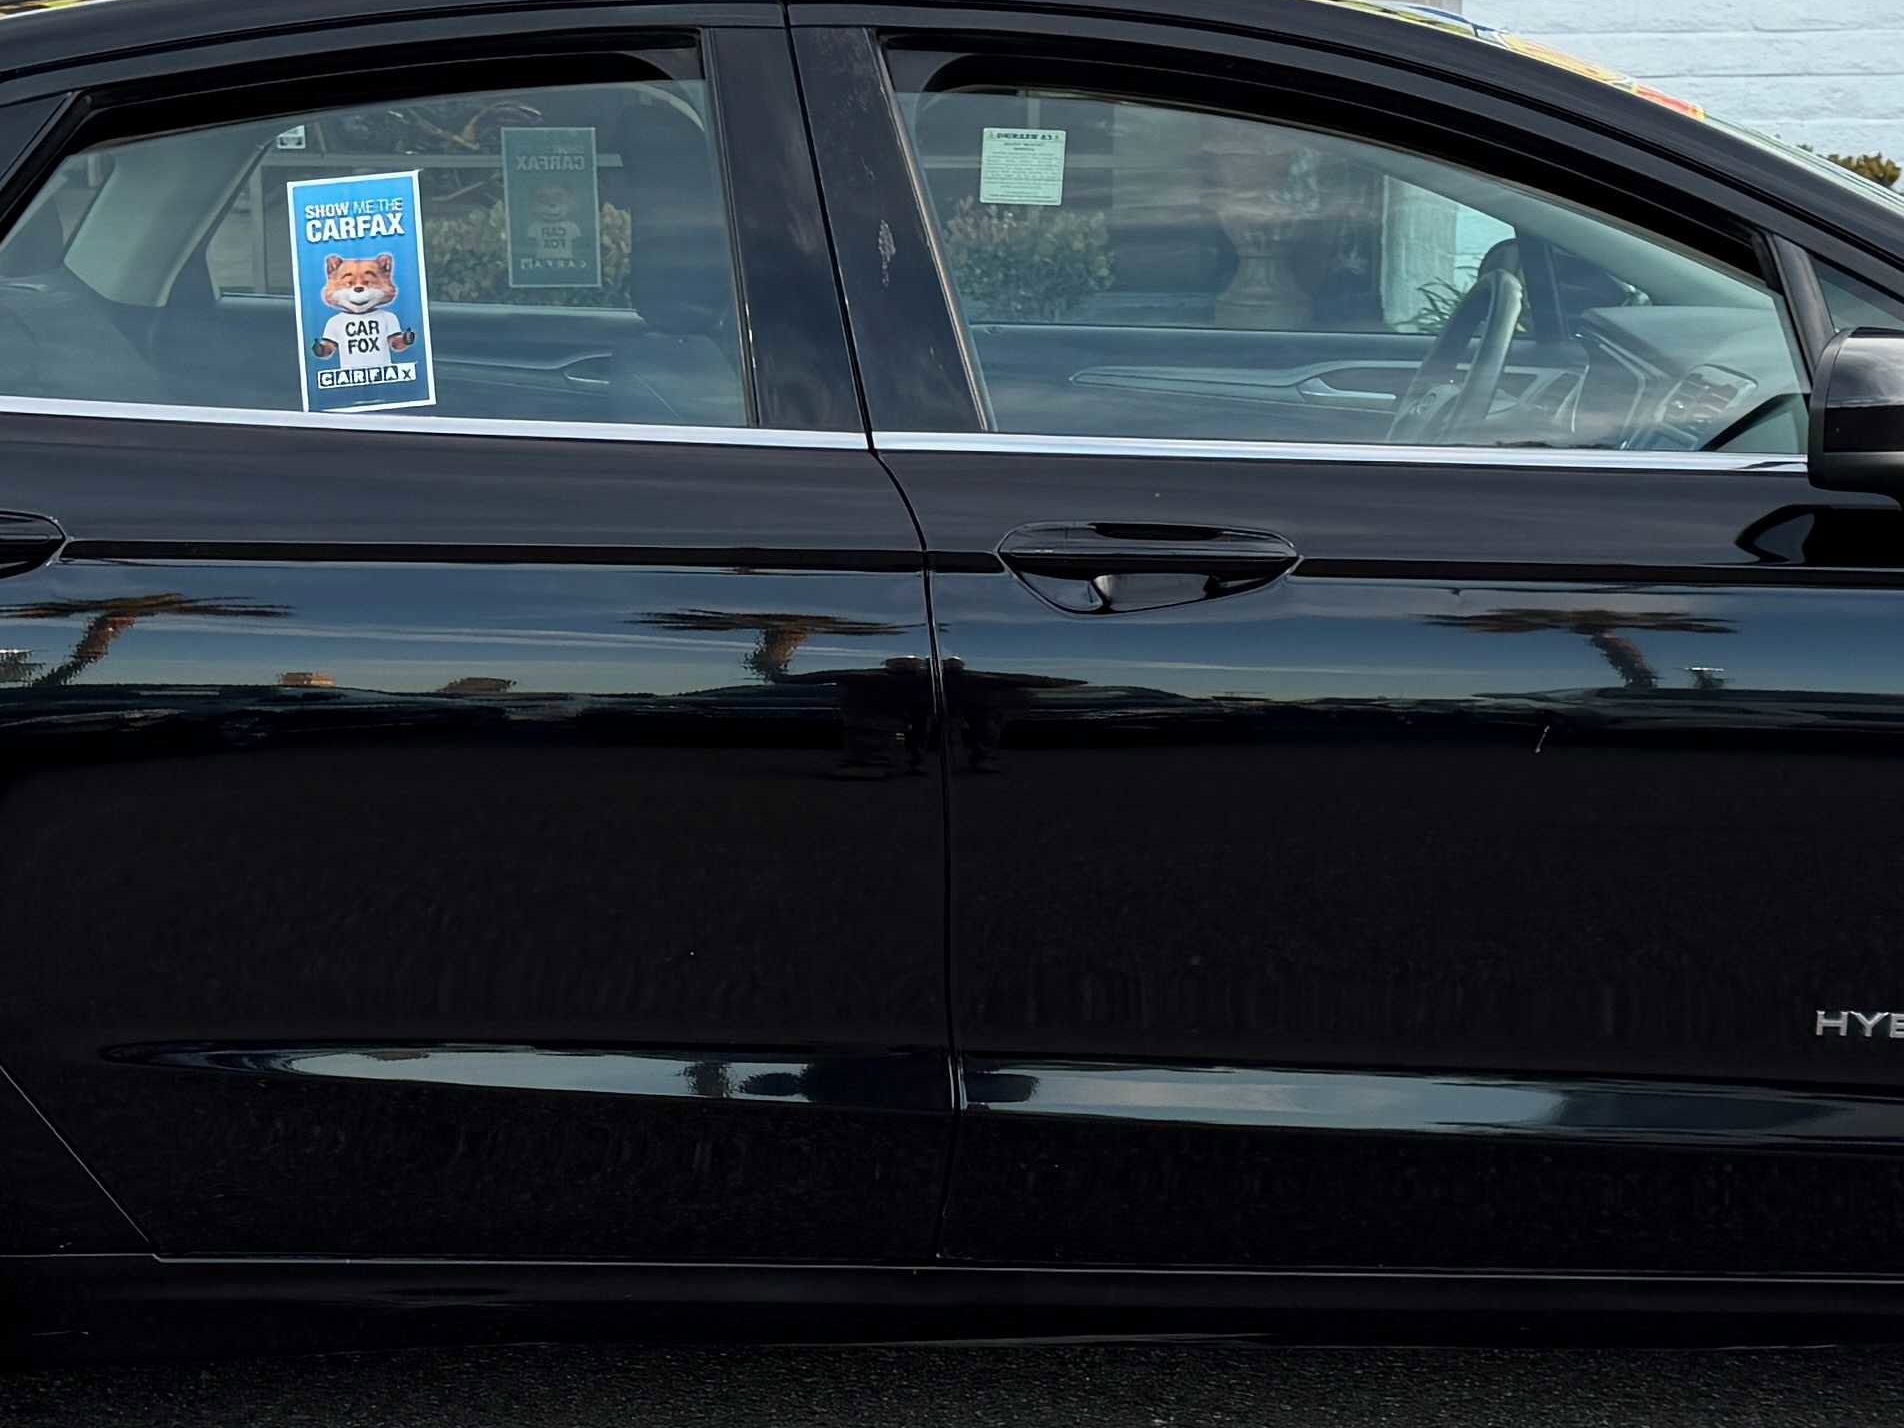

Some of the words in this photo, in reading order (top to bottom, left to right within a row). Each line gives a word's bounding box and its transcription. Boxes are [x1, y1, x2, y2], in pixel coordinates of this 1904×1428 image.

[304, 200, 350, 221] SHOW
[352, 198, 375, 215] ME
[376, 196, 404, 213] THE
[305, 212, 406, 244] CARFAX
[345, 320, 380, 338] CAR
[347, 337, 381, 355] FOX
[319, 366, 414, 388] CARFAX
